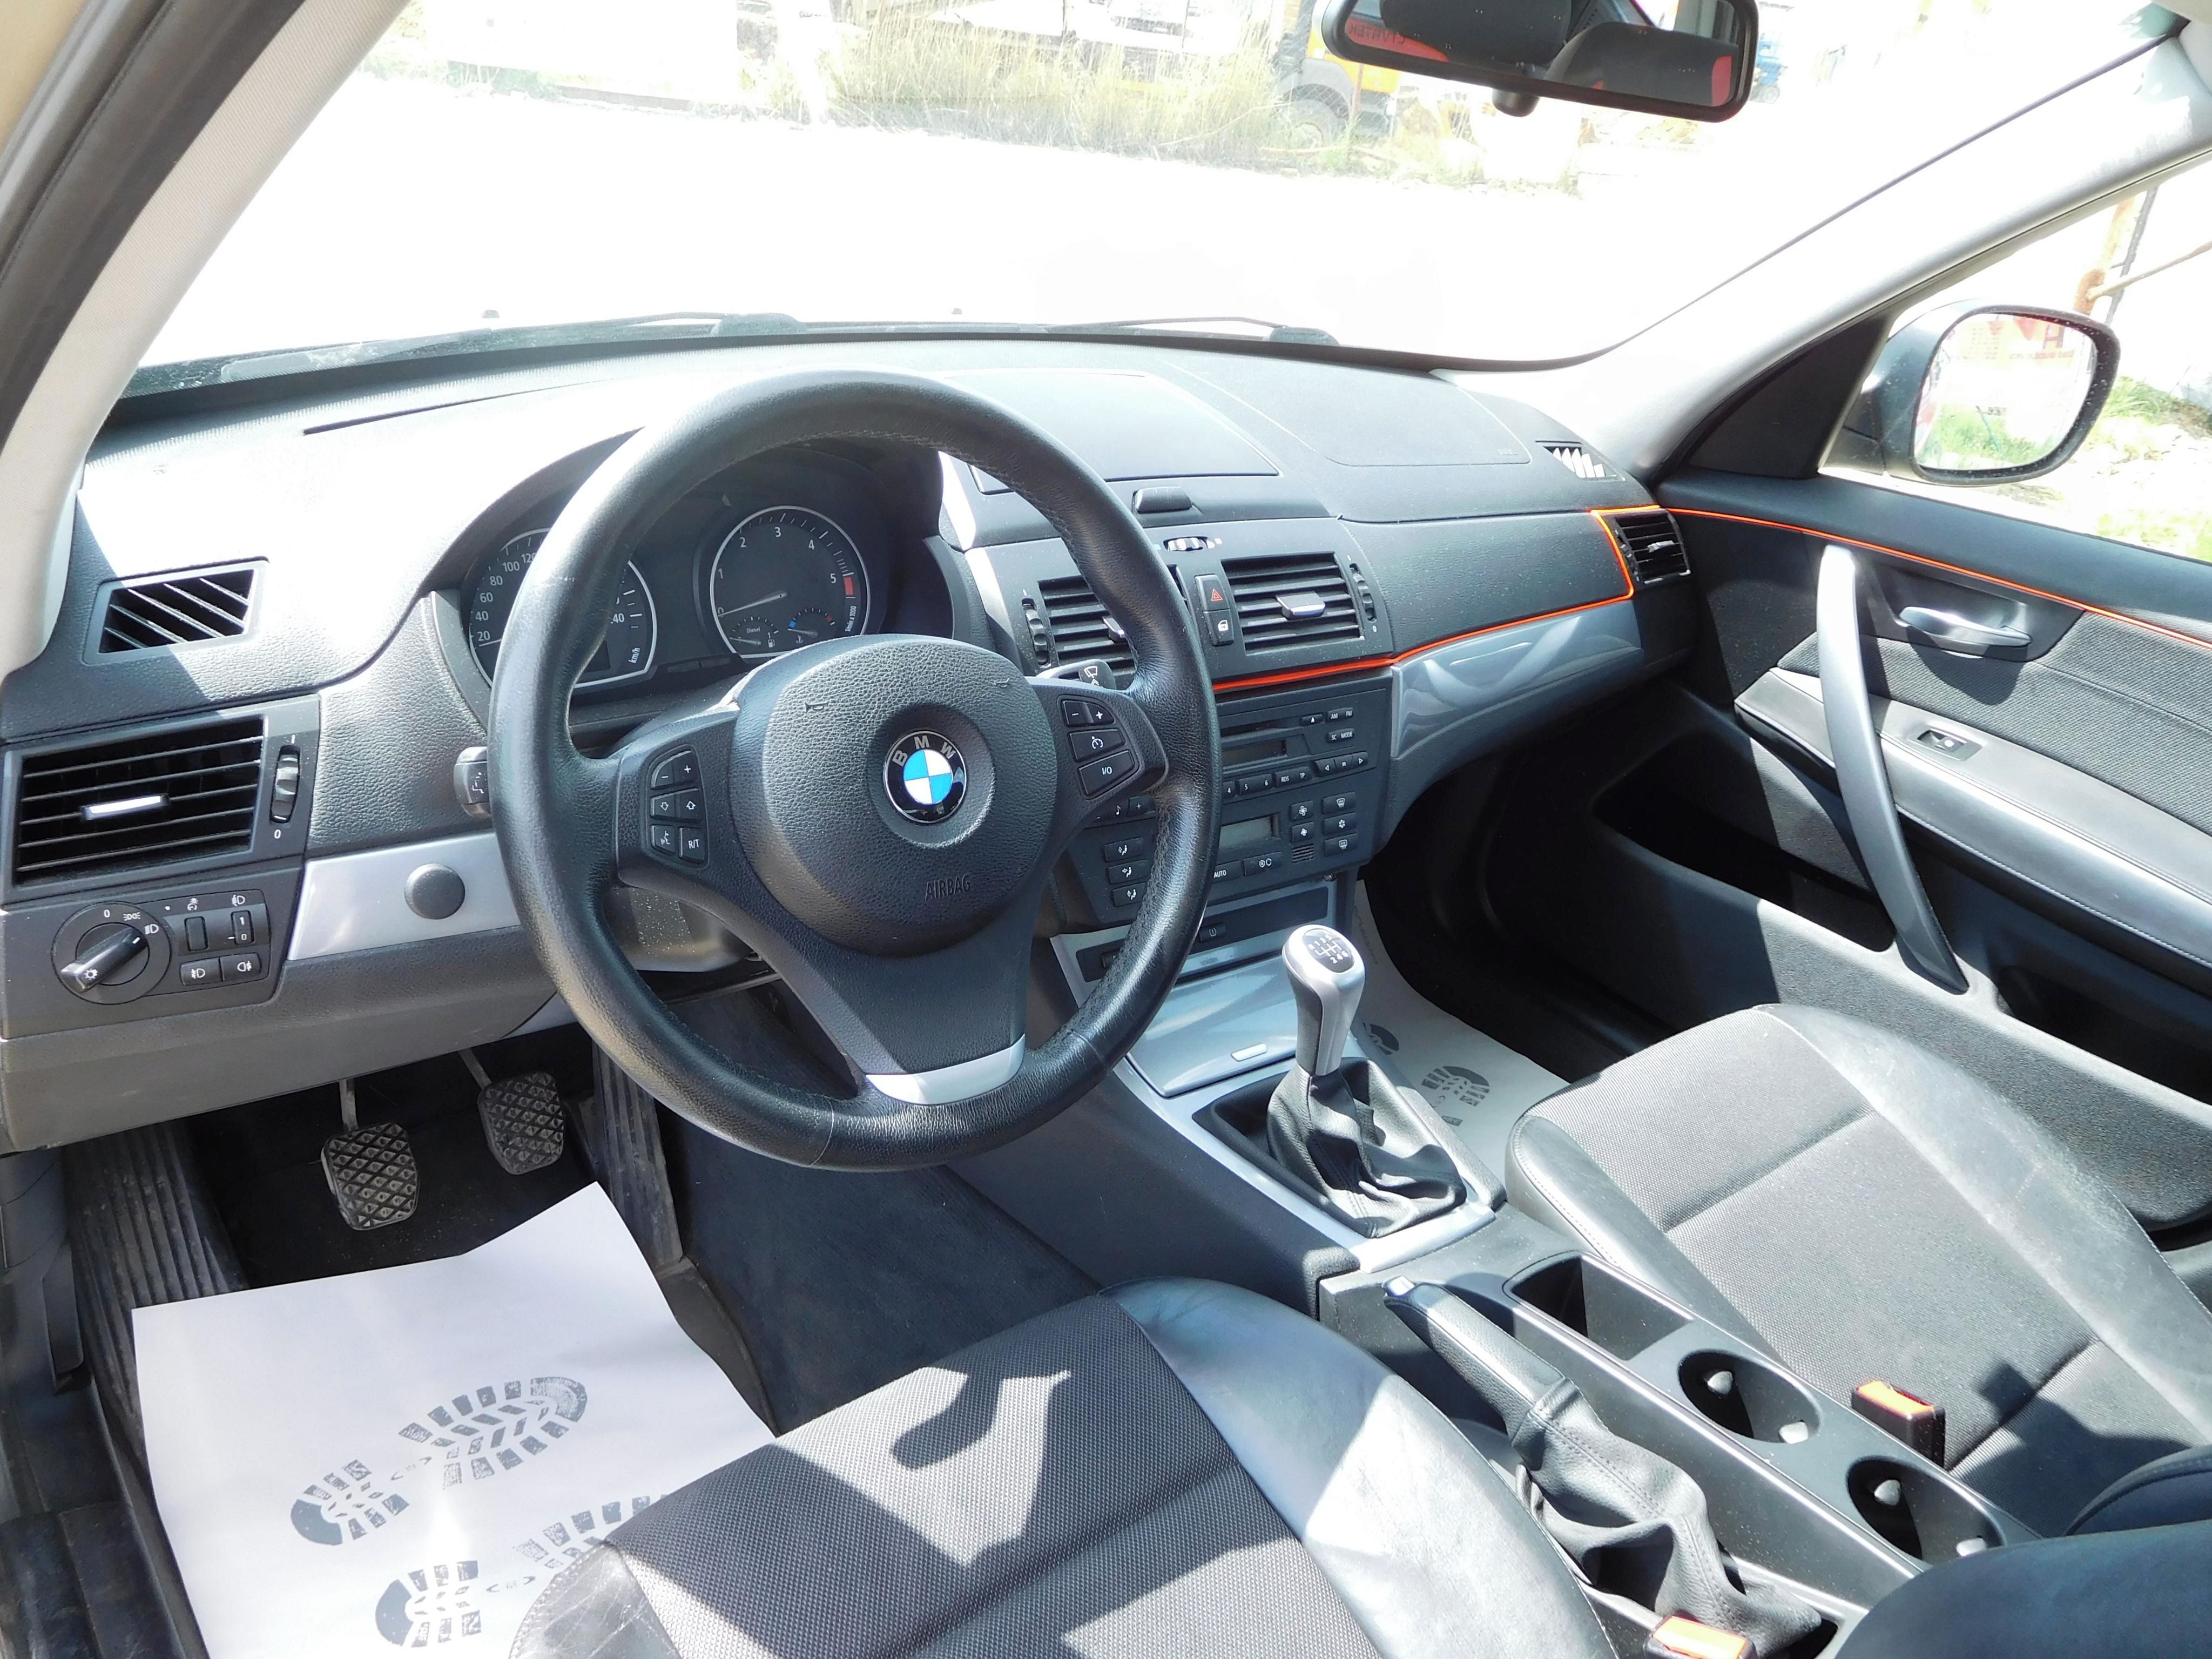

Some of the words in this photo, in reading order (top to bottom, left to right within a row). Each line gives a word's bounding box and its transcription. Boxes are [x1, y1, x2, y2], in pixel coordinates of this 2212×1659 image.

[774, 527, 781, 537] 3
[739, 537, 746, 548] 2
[808, 539, 815, 550] 4
[502, 561, 520, 572] 100
[718, 568, 724, 579] 1
[830, 573, 837, 584] 5
[490, 575, 503, 586] 80
[480, 592, 493, 603] 60
[475, 611, 489, 621] 40
[610, 613, 625, 624] 40
[477, 631, 490, 641] 20
[628, 648, 641, 663] km/h
[892, 735, 956, 767] BMW
[688, 839, 699, 849] R/T
[1213, 869, 1226, 878] AUTO
[925, 873, 970, 902] AIRBAG
[240, 916, 245, 925] 1
